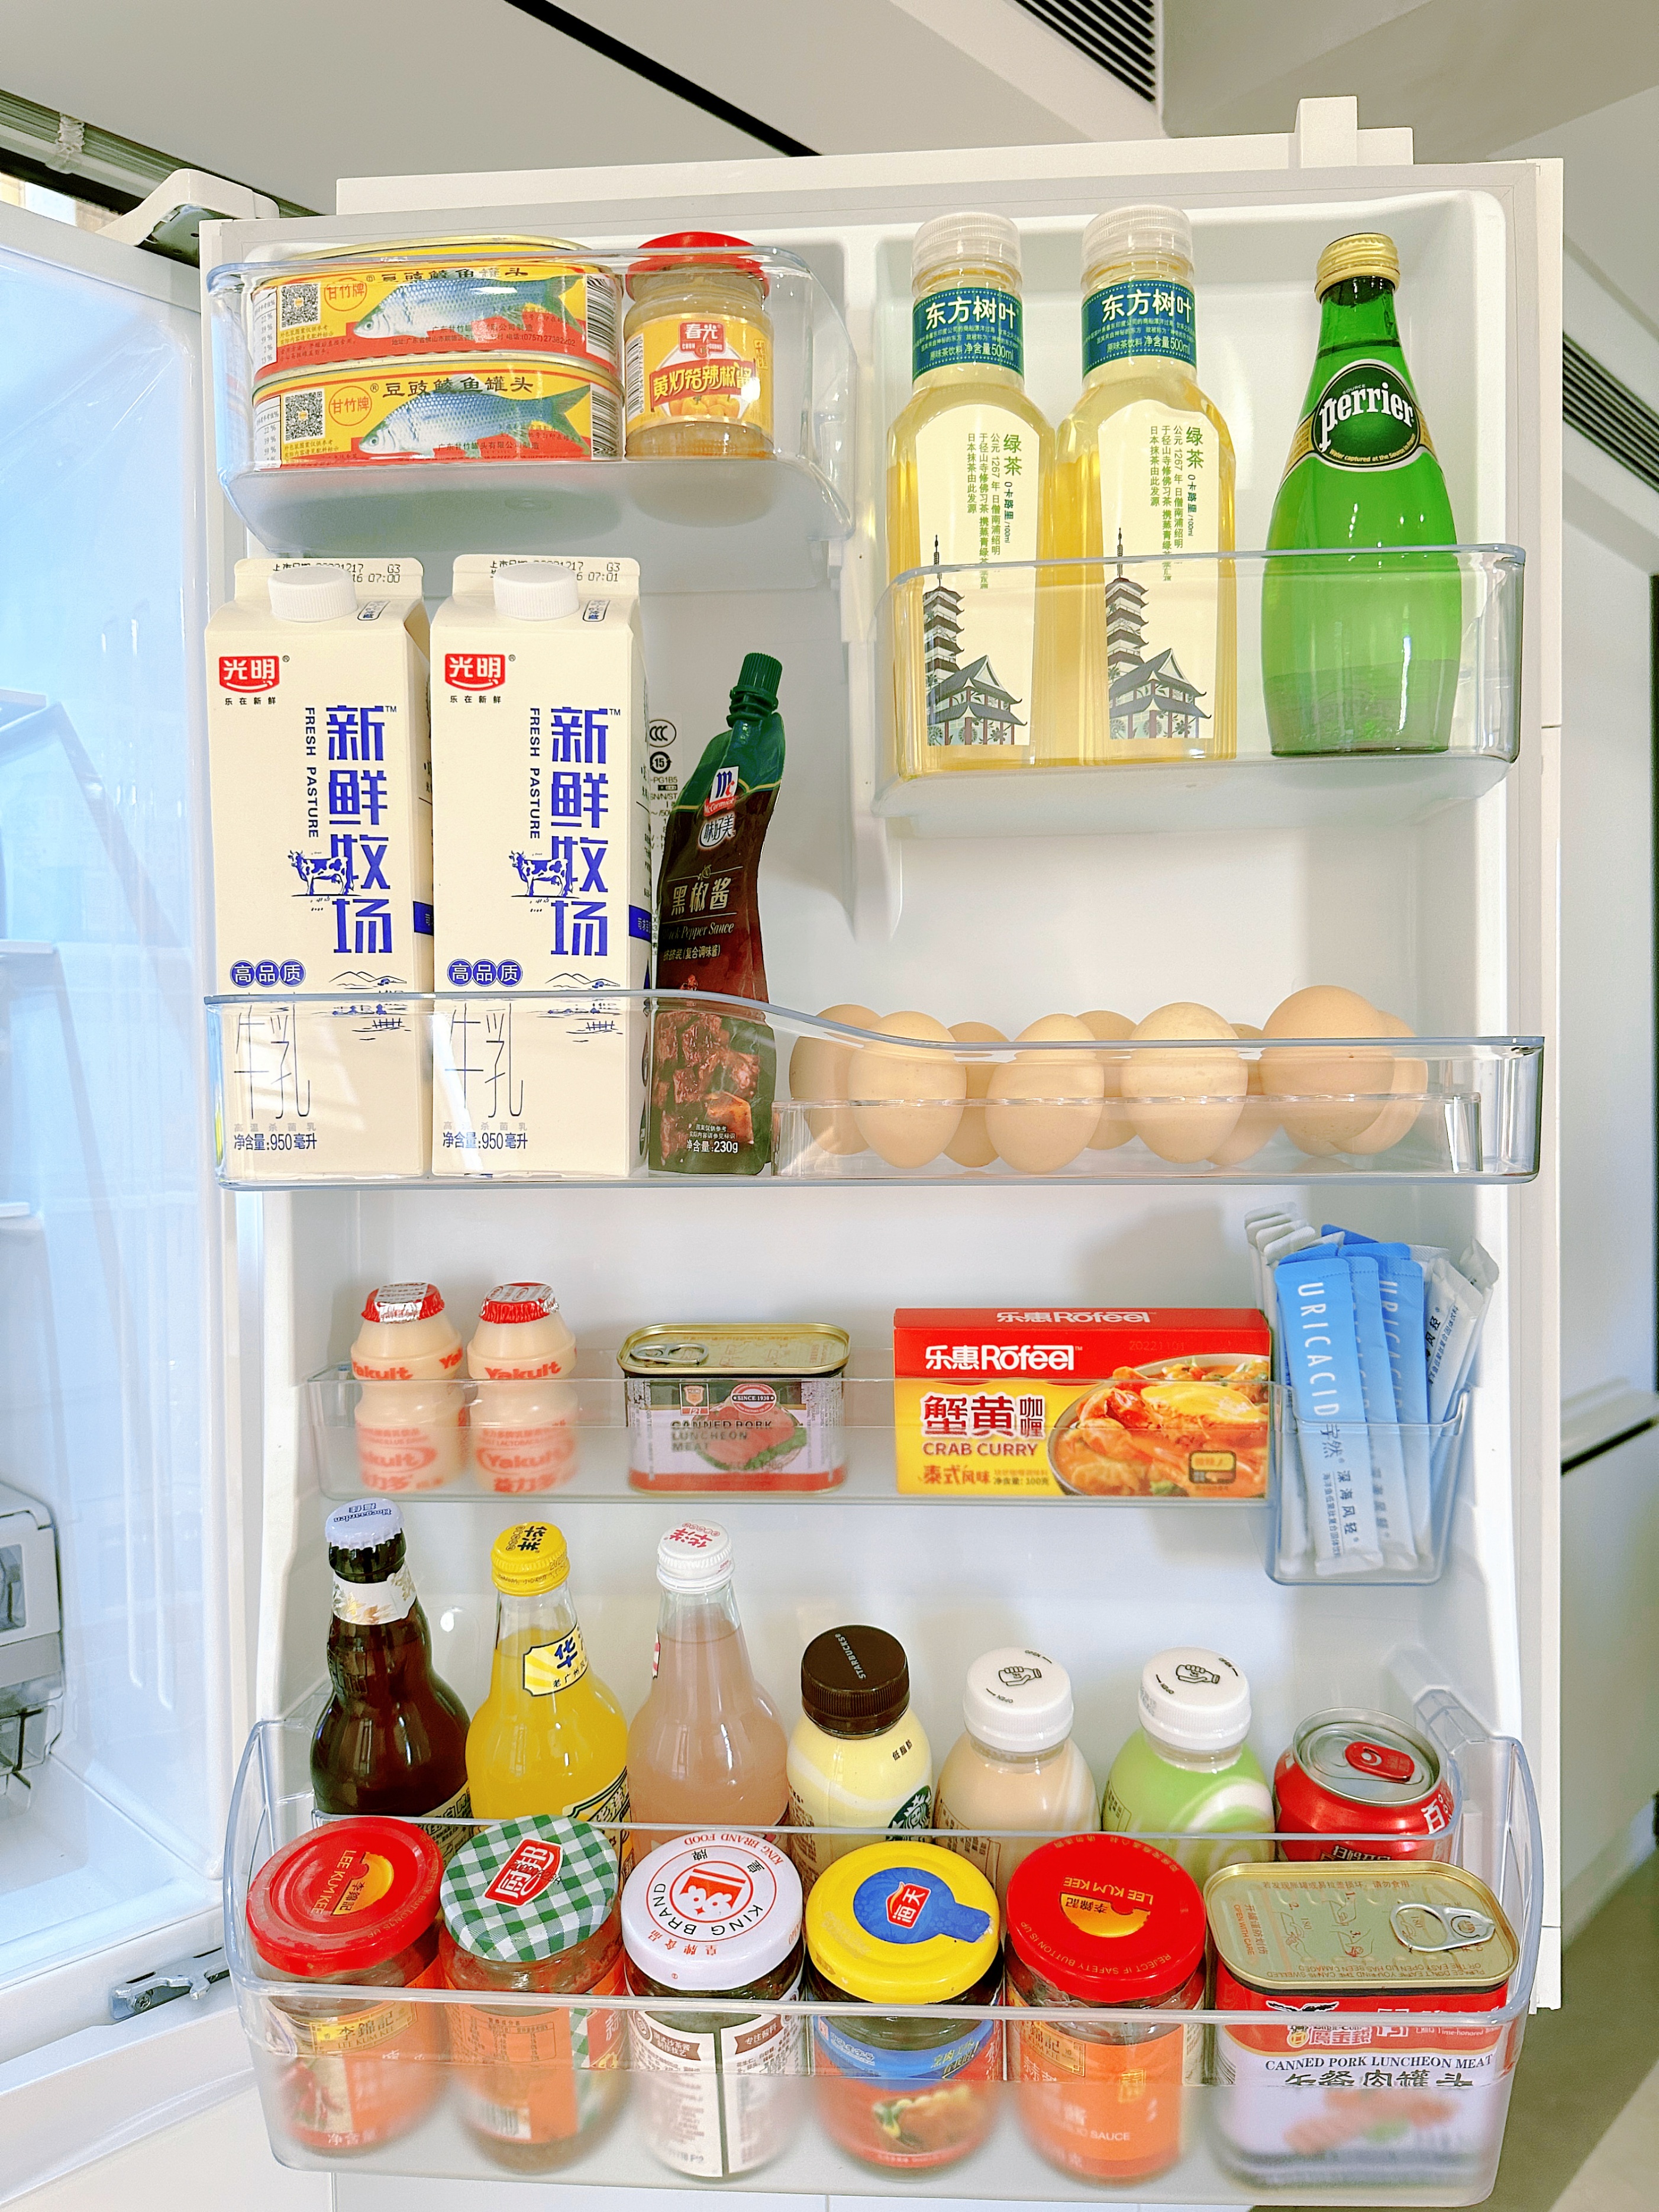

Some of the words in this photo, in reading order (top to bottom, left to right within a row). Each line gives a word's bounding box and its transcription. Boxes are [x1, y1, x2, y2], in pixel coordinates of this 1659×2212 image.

[926, 295, 1016, 330] 东方树叶
[1102, 288, 1192, 323] 东方树叶
[685, 324, 718, 343] 春光
[383, 377, 533, 398] 豆豉鲮鱼罐头
[653, 362, 752, 401] 黄灯笼辣椒酱
[1342, 384, 1366, 395] SOURCE
[331, 396, 370, 414] 甘竹牌
[1003, 434, 1022, 476] 绿茶
[1186, 427, 1204, 469] 绿茶
[388, 564, 401, 573] G3
[588, 572, 619, 582] 07:01
[606, 563, 620, 572] G3
[368, 573, 401, 583] 07:00
[223, 659, 276, 681] 光明
[449, 656, 502, 679] 光明
[224, 697, 277, 705] 乐在新鲜
[450, 695, 502, 704] 乐在新鲜
[305, 707, 317, 756] FRESH
[530, 708, 540, 757] FRESH
[654, 758, 664, 768] 15
[306, 767, 318, 839] PASTURE
[530, 768, 541, 839] PASTURE
[326, 705, 392, 954] 新鲜牧场
[551, 707, 609, 956] 新鲜牧场
[703, 814, 734, 843] 味好美
[671, 877, 731, 916] 黑椒酱
[681, 926, 708, 940] Pepper
[708, 921, 734, 935] Sauce
[234, 963, 304, 983] 高品质
[451, 963, 519, 982] 高品质
[686, 1139, 738, 1153] 净含量:230g
[1297, 1282, 1340, 1417] URICACID
[485, 1360, 562, 1379] Yakult
[672, 1431, 748, 1441] LUNCHEON
[922, 1442, 973, 1456] CRAB
[976, 1442, 1038, 1456] CURRY
[923, 1463, 991, 1485] 泰式风味
[834, 1632, 867, 1680] STARBUCKS
[892, 1739, 912, 1762] 低脂肪
[684, 1833, 715, 1846] FOOD
[721, 1833, 761, 1849] BRAND
[760, 1845, 784, 1865] KING
[336, 1850, 357, 1870] LEE
[322, 1870, 346, 1894] KUM
[1063, 1876, 1090, 1891] KEE
[1093, 1882, 1125, 1898] KUM
[310, 1894, 333, 1916] KEE
[892, 1888, 925, 1923] 海天
[1127, 1889, 1154, 1905] LEE
[653, 1882, 698, 1935] BRAND
[1234, 1904, 1244, 1921] OPEN
[711, 1904, 763, 1936] KING
[1021, 1921, 1032, 1934] UP
[1239, 1921, 1250, 1938] WITH
[1038, 1941, 1076, 1966] BUTTON
[1244, 1937, 1255, 1956] CARE
[1078, 1963, 1119, 1974] SAFETY
[1136, 1953, 1172, 1972] REJECT
[337, 2040, 351, 2049] LEE
[356, 2034, 378, 2046] KUM
[380, 2026, 395, 2037] KEE
[1265, 2057, 1325, 2071] CANNED
[1328, 2055, 1368, 2068] PORK
[1371, 2055, 1453, 2069] LUNCHEON
[1455, 2053, 1494, 2069] MEAT
[1090, 2130, 1131, 2141] SAUCE
